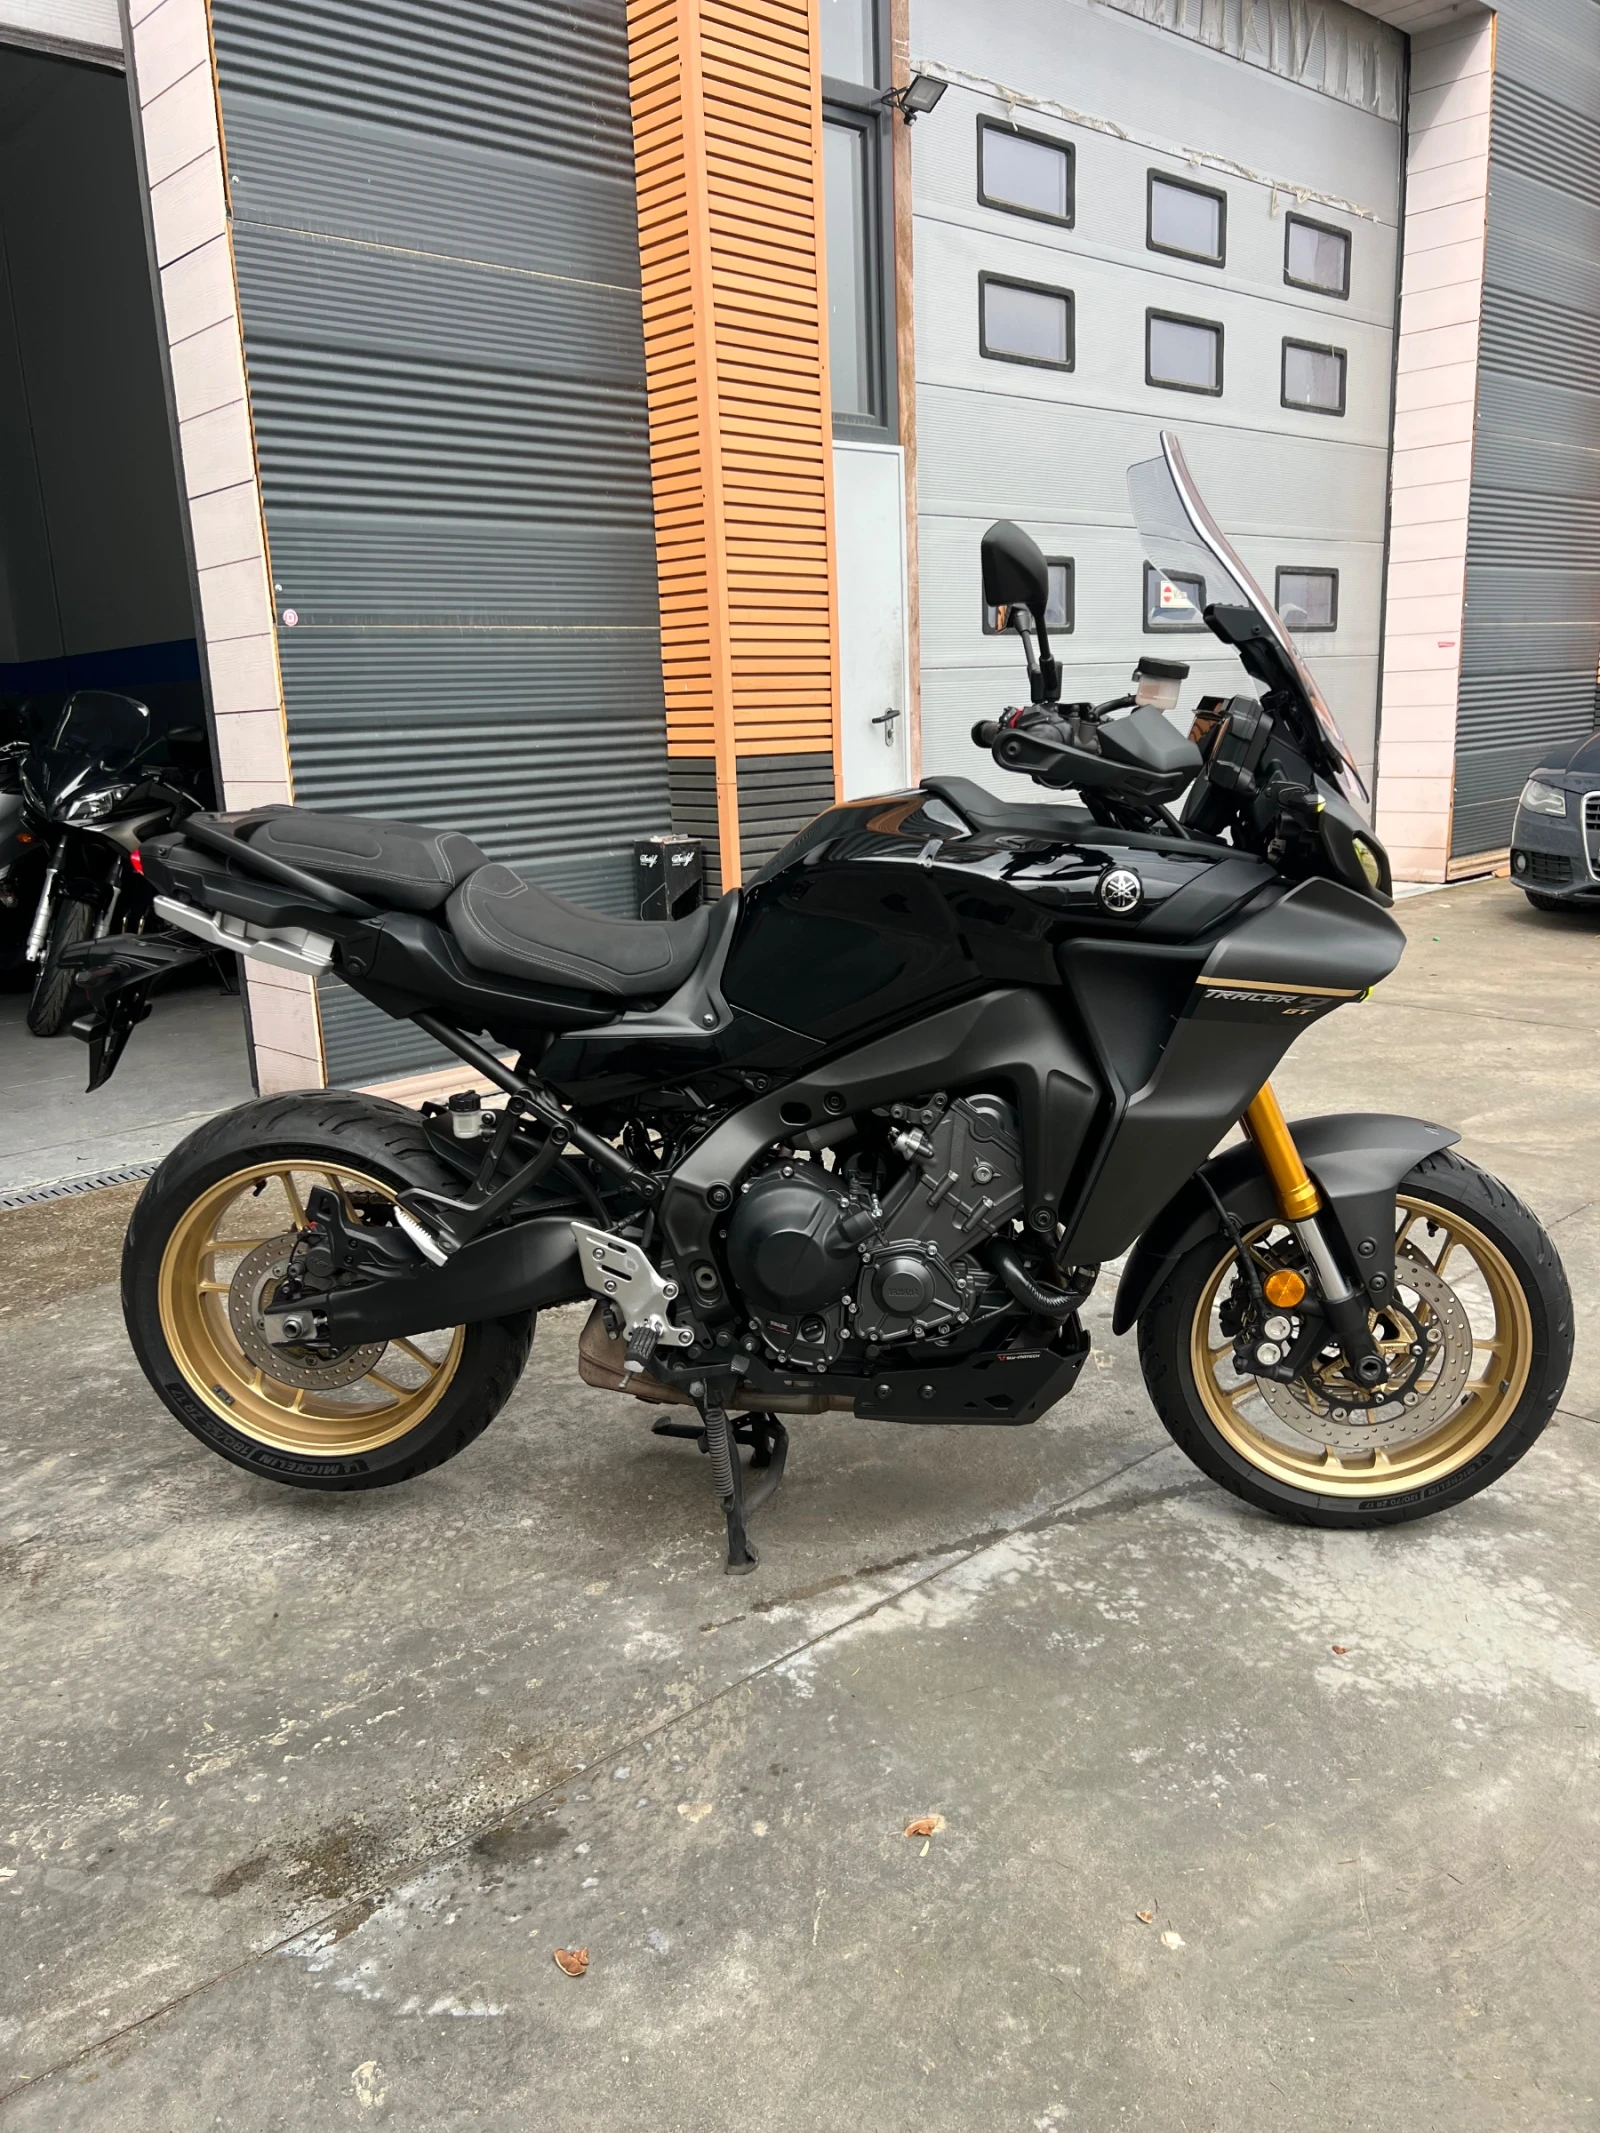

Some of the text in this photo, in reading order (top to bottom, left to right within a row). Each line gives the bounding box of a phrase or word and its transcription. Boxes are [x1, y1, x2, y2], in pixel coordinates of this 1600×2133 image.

[1204, 989, 1333, 1009] TRACER 9
[888, 1287, 919, 1297] YAMAHA
[173, 1388, 340, 1475] MICHELIN 180/55 ZR 17
[1428, 1466, 1476, 1496] MICHELIN
[1376, 1500, 1388, 1508] ZR
[1390, 1493, 1418, 1506] 120/70
